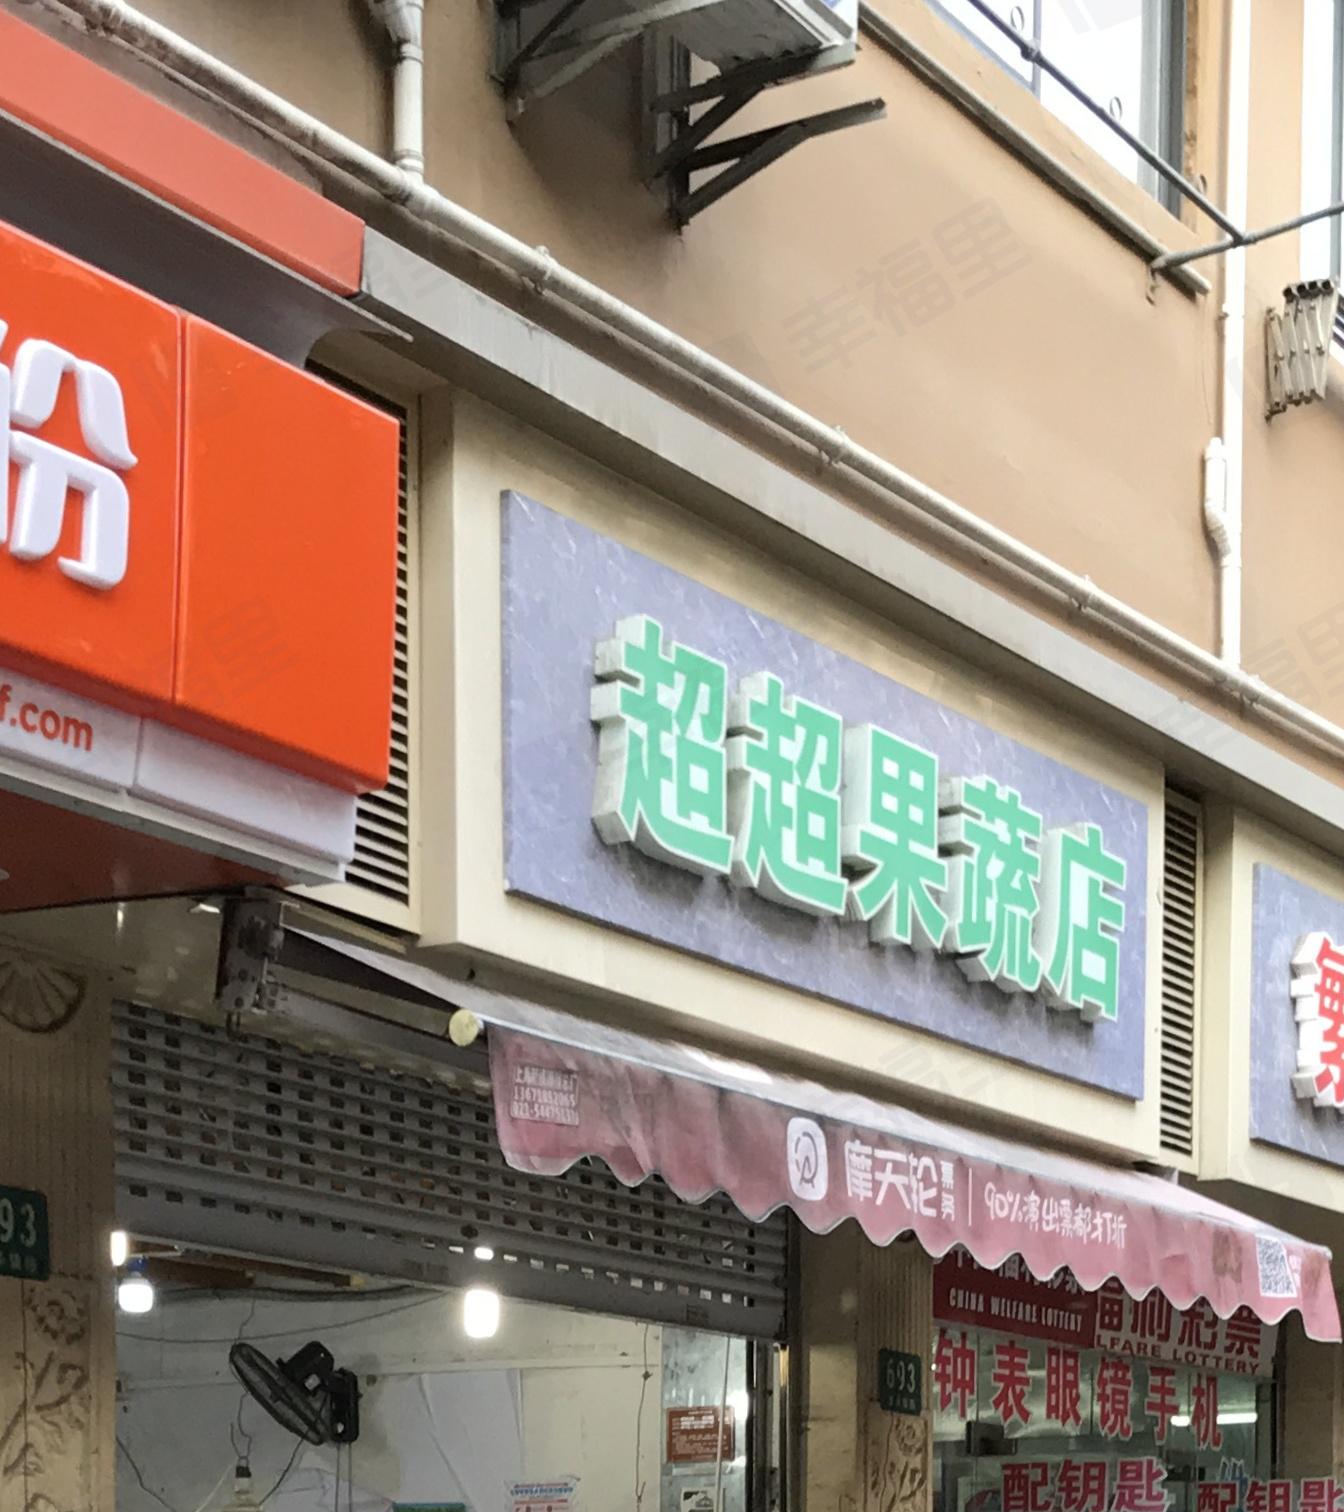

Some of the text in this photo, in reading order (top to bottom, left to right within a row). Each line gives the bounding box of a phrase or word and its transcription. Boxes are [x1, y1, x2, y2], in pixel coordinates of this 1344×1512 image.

[592, 614, 1128, 1021] 超超果蔬店
[844, 1140, 937, 1219] 摩天轮
[949, 1287, 1082, 1333] CHINA WELFARE LOTTERY
[886, 1358, 916, 1394] 693
[933, 1327, 1224, 1451] 钟表眼镜手机
[1173, 1350, 1260, 1376] LOTTERY
